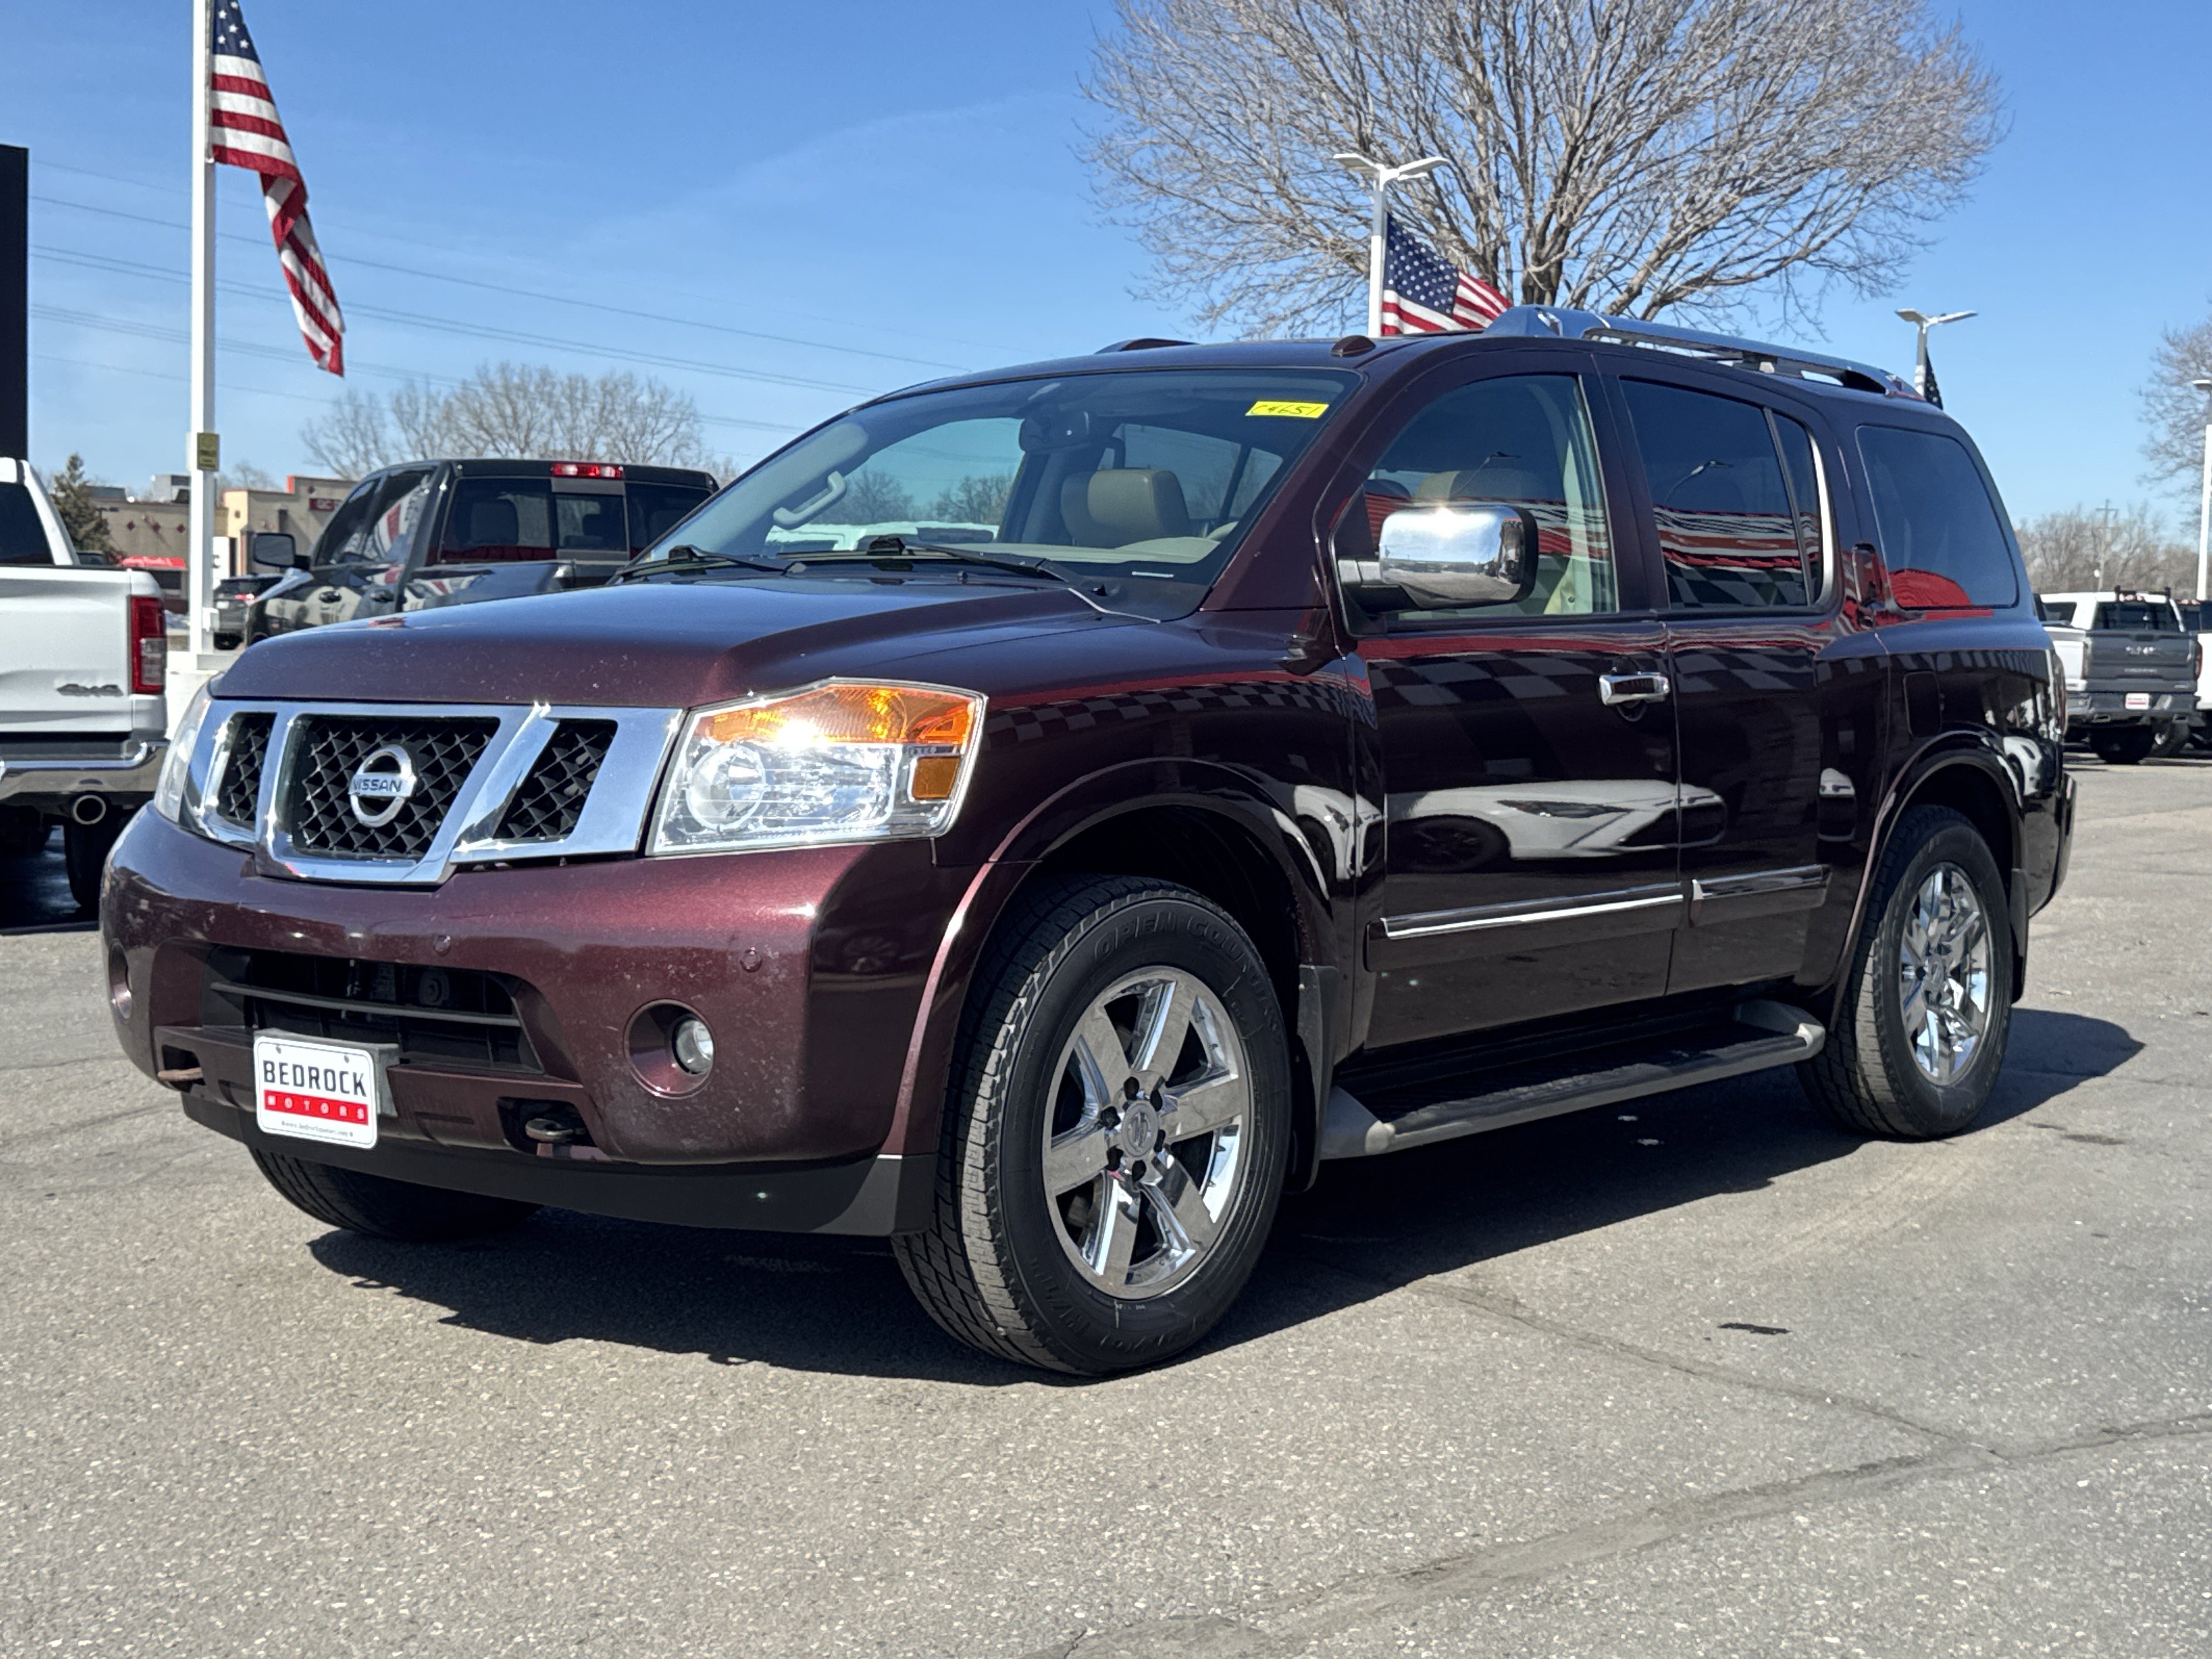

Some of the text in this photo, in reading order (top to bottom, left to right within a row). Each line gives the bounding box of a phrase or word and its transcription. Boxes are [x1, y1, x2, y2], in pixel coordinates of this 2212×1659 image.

[353, 778, 403, 792] NISSAN
[1094, 911, 1178, 961] OPEN
[263, 1060, 366, 1097] BEDROCK
[267, 1095, 365, 1120] MOTORS
